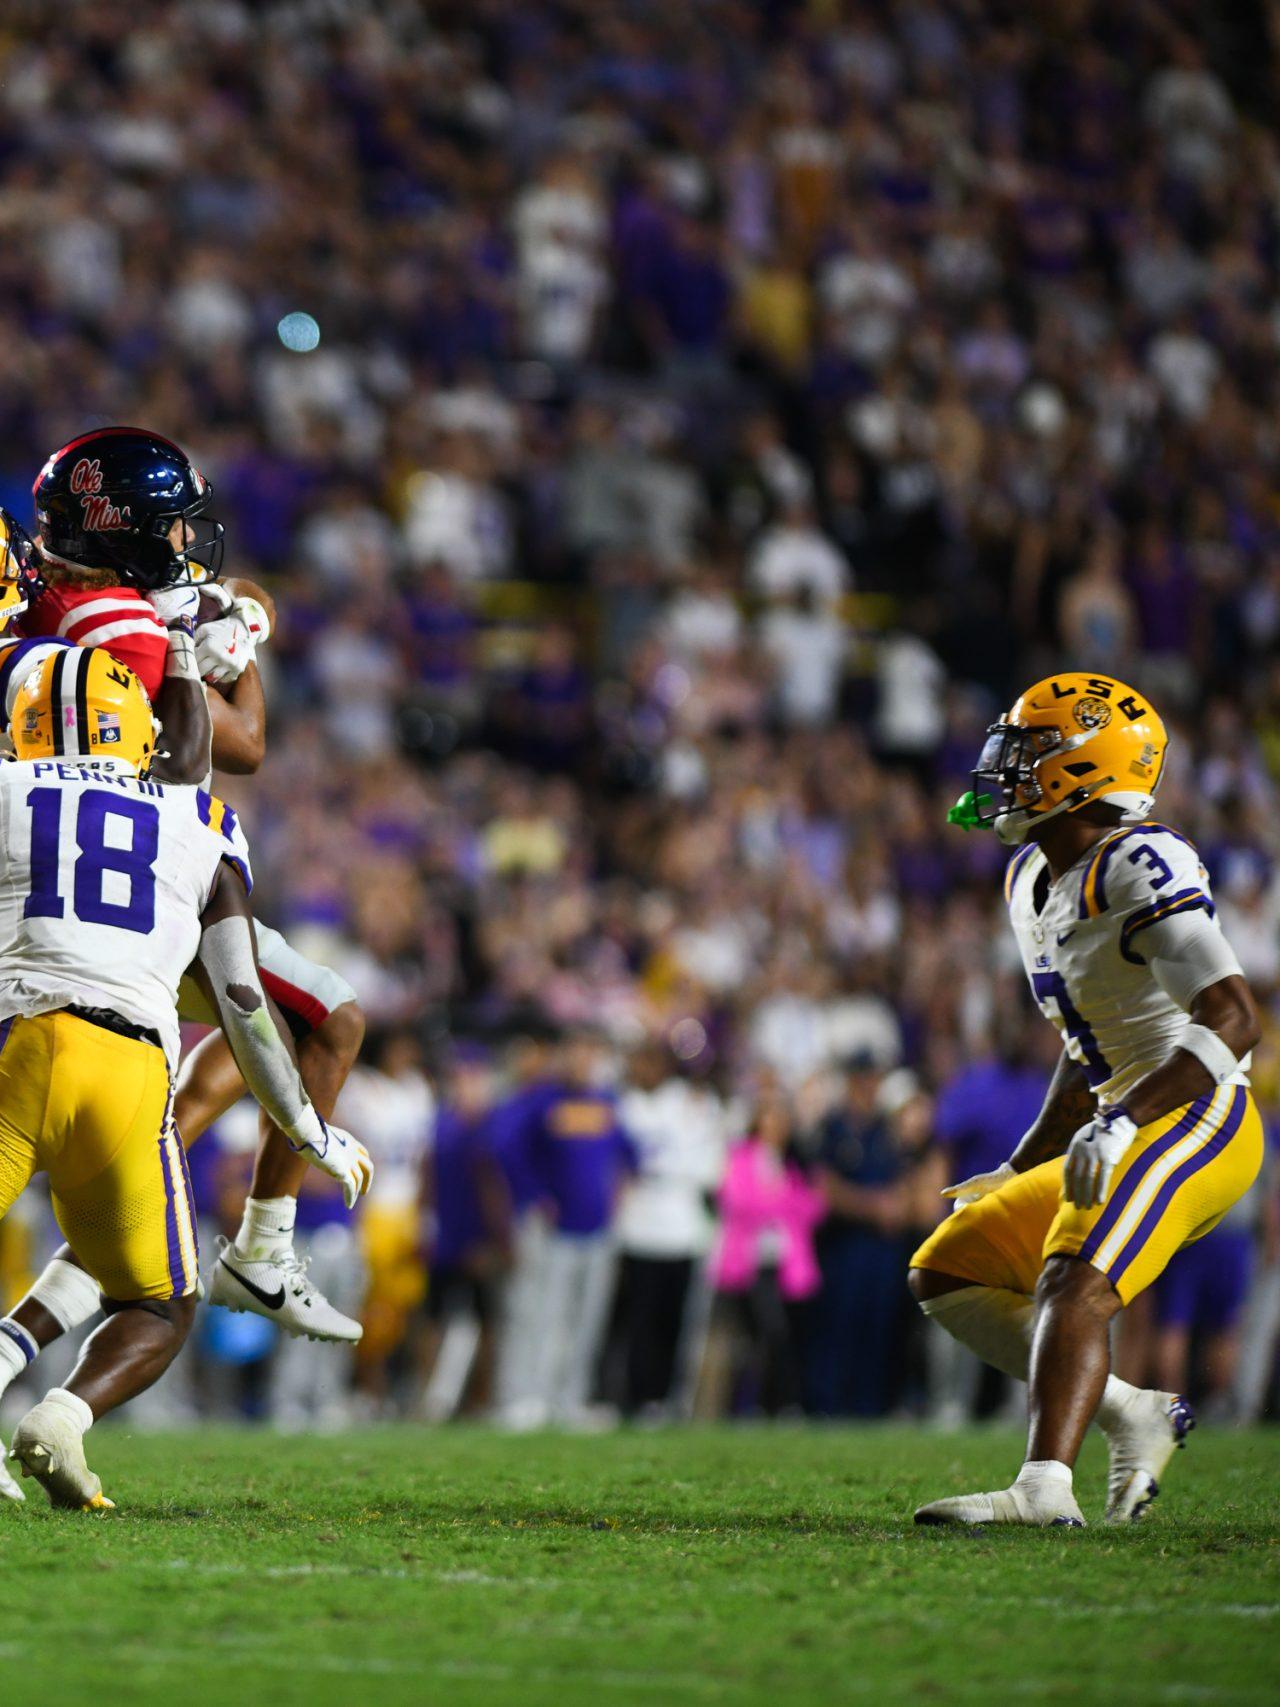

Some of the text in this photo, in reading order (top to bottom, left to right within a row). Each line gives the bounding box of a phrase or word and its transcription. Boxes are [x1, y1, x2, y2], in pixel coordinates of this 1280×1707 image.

[71, 459, 103, 494] Ole
[81, 495, 132, 531] Miss
[33, 763, 164, 798] PENN III
[23, 787, 160, 935] 18
[1128, 844, 1173, 890] 3
